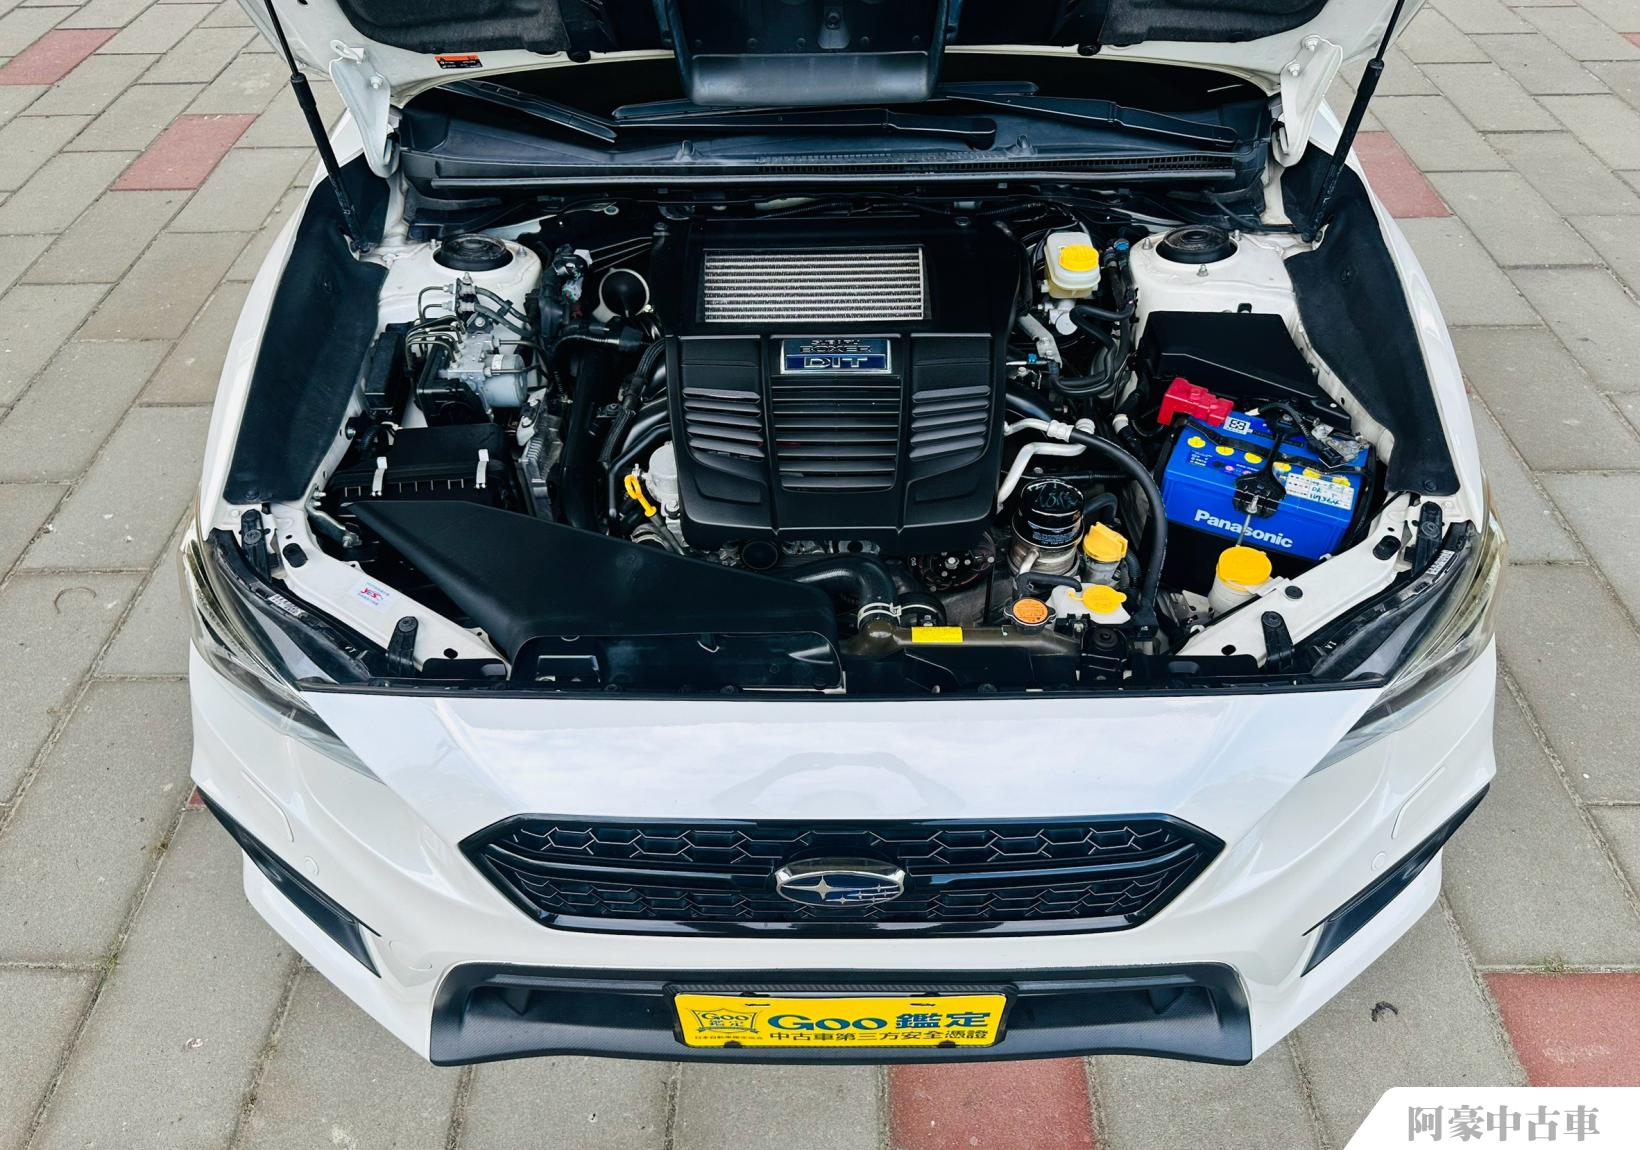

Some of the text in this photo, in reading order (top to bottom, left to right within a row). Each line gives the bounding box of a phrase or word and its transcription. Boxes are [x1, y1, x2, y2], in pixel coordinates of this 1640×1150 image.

[804, 357, 867, 368] DIT
[1194, 509, 1293, 548] Panasonic
[768, 1012, 990, 1030] Goo 鑑定
